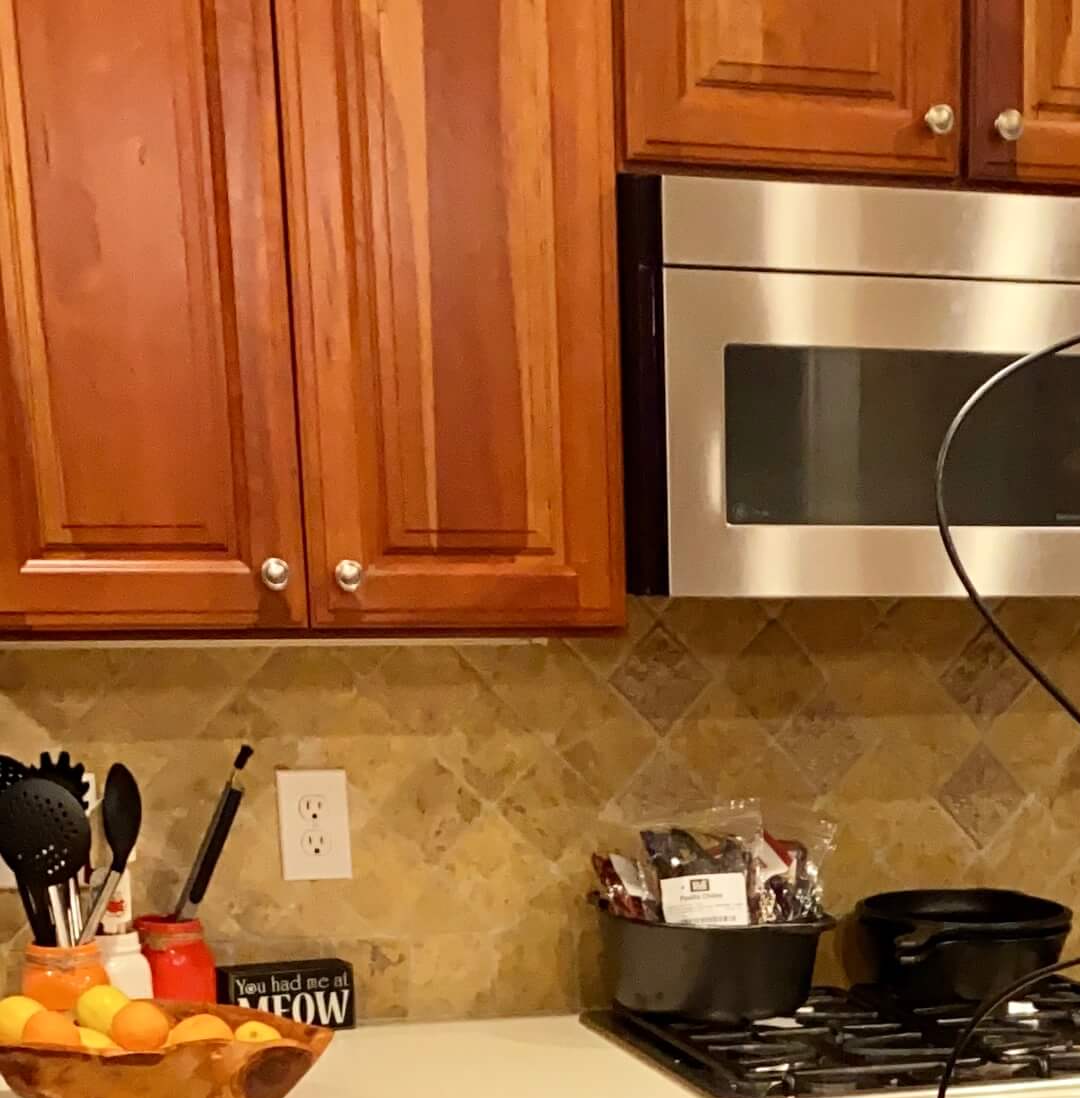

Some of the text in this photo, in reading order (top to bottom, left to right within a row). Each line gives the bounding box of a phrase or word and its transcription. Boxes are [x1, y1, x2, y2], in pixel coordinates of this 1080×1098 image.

[236, 971, 350, 996] You had me at
